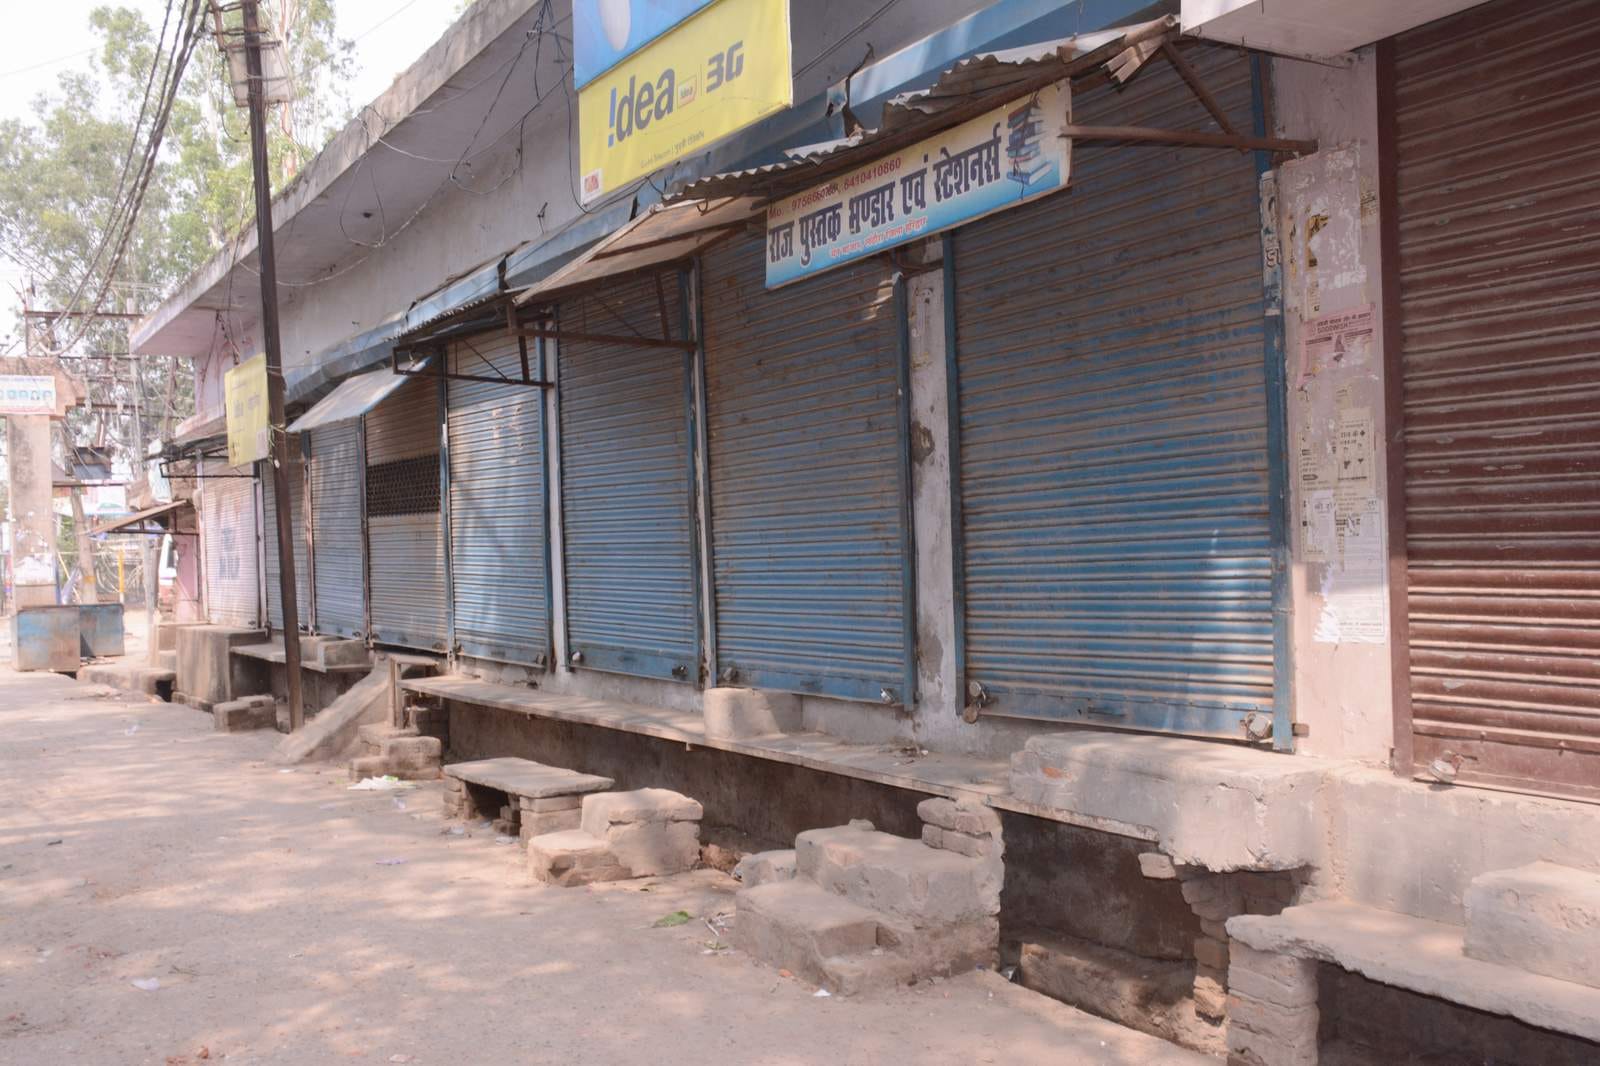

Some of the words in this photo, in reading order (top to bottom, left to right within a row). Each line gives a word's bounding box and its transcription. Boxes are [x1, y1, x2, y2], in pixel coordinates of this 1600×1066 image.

[706, 40, 745, 94] 3G
[767, 222, 794, 265] राज
[798, 201, 842, 266] पुस्तक
[848, 181, 896, 236] भण्डार
[899, 154, 929, 216] एवं
[932, 122, 1002, 203] स्टेशनर्स
